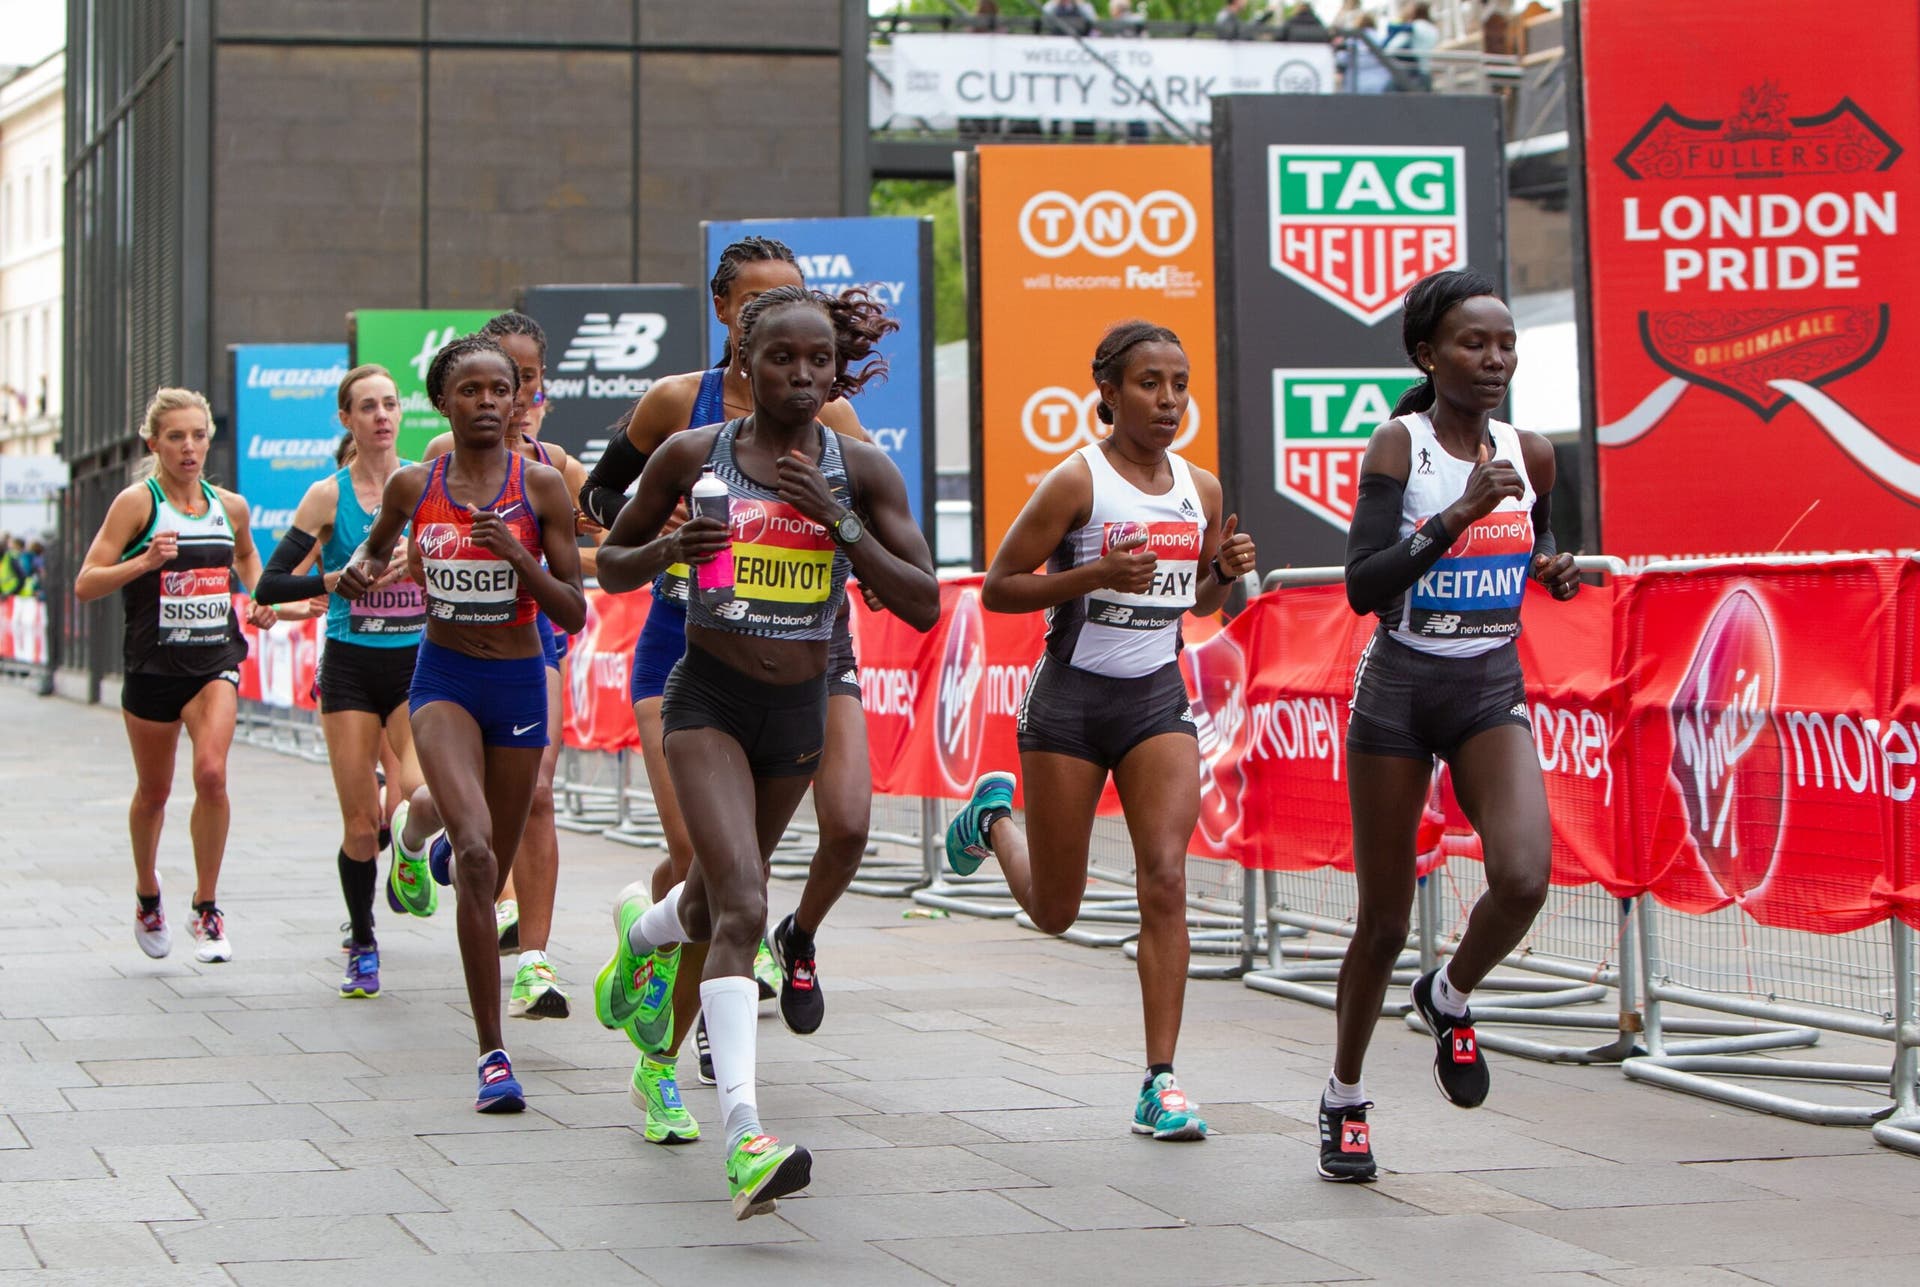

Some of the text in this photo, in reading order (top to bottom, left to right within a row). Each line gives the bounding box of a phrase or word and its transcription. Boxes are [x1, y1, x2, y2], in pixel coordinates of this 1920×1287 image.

[1023, 50, 1153, 66] WELCOE TO
[957, 71, 1096, 103] CUTTY
[1112, 75, 1217, 106] SARK
[1287, 160, 1445, 211] TAG
[1624, 191, 1897, 240] LONDON
[799, 254, 853, 278] ATA
[1285, 228, 1452, 308] HEUER
[1664, 245, 1860, 293] PRIDE
[1024, 274, 1052, 289] will
[1054, 275, 1121, 289] become
[1694, 315, 1836, 366] ORIGINAL ALE
[588, 375, 652, 399] balan
[1292, 384, 1391, 433] TA
[248, 435, 341, 459] Lucozad
[421, 524, 456, 557] Virgin
[1151, 533, 1198, 550] money
[1474, 523, 1528, 540] money
[1410, 537, 1434, 557] adidas
[166, 573, 228, 595] Virgin money
[426, 566, 515, 592] KOSGEI
[733, 556, 828, 590] ERUIYOT
[1417, 566, 1525, 599] KEITANY
[164, 601, 228, 620] SISSON
[474, 612, 510, 621] balance
[748, 613, 771, 624] new
[1131, 619, 1149, 627] new
[384, 625, 399, 633] new
[1461, 626, 1482, 634] new
[987, 665, 1030, 717] mon
[1246, 696, 1340, 781] money
[1529, 703, 1613, 807] oney
[1679, 657, 1766, 859] Virgin
